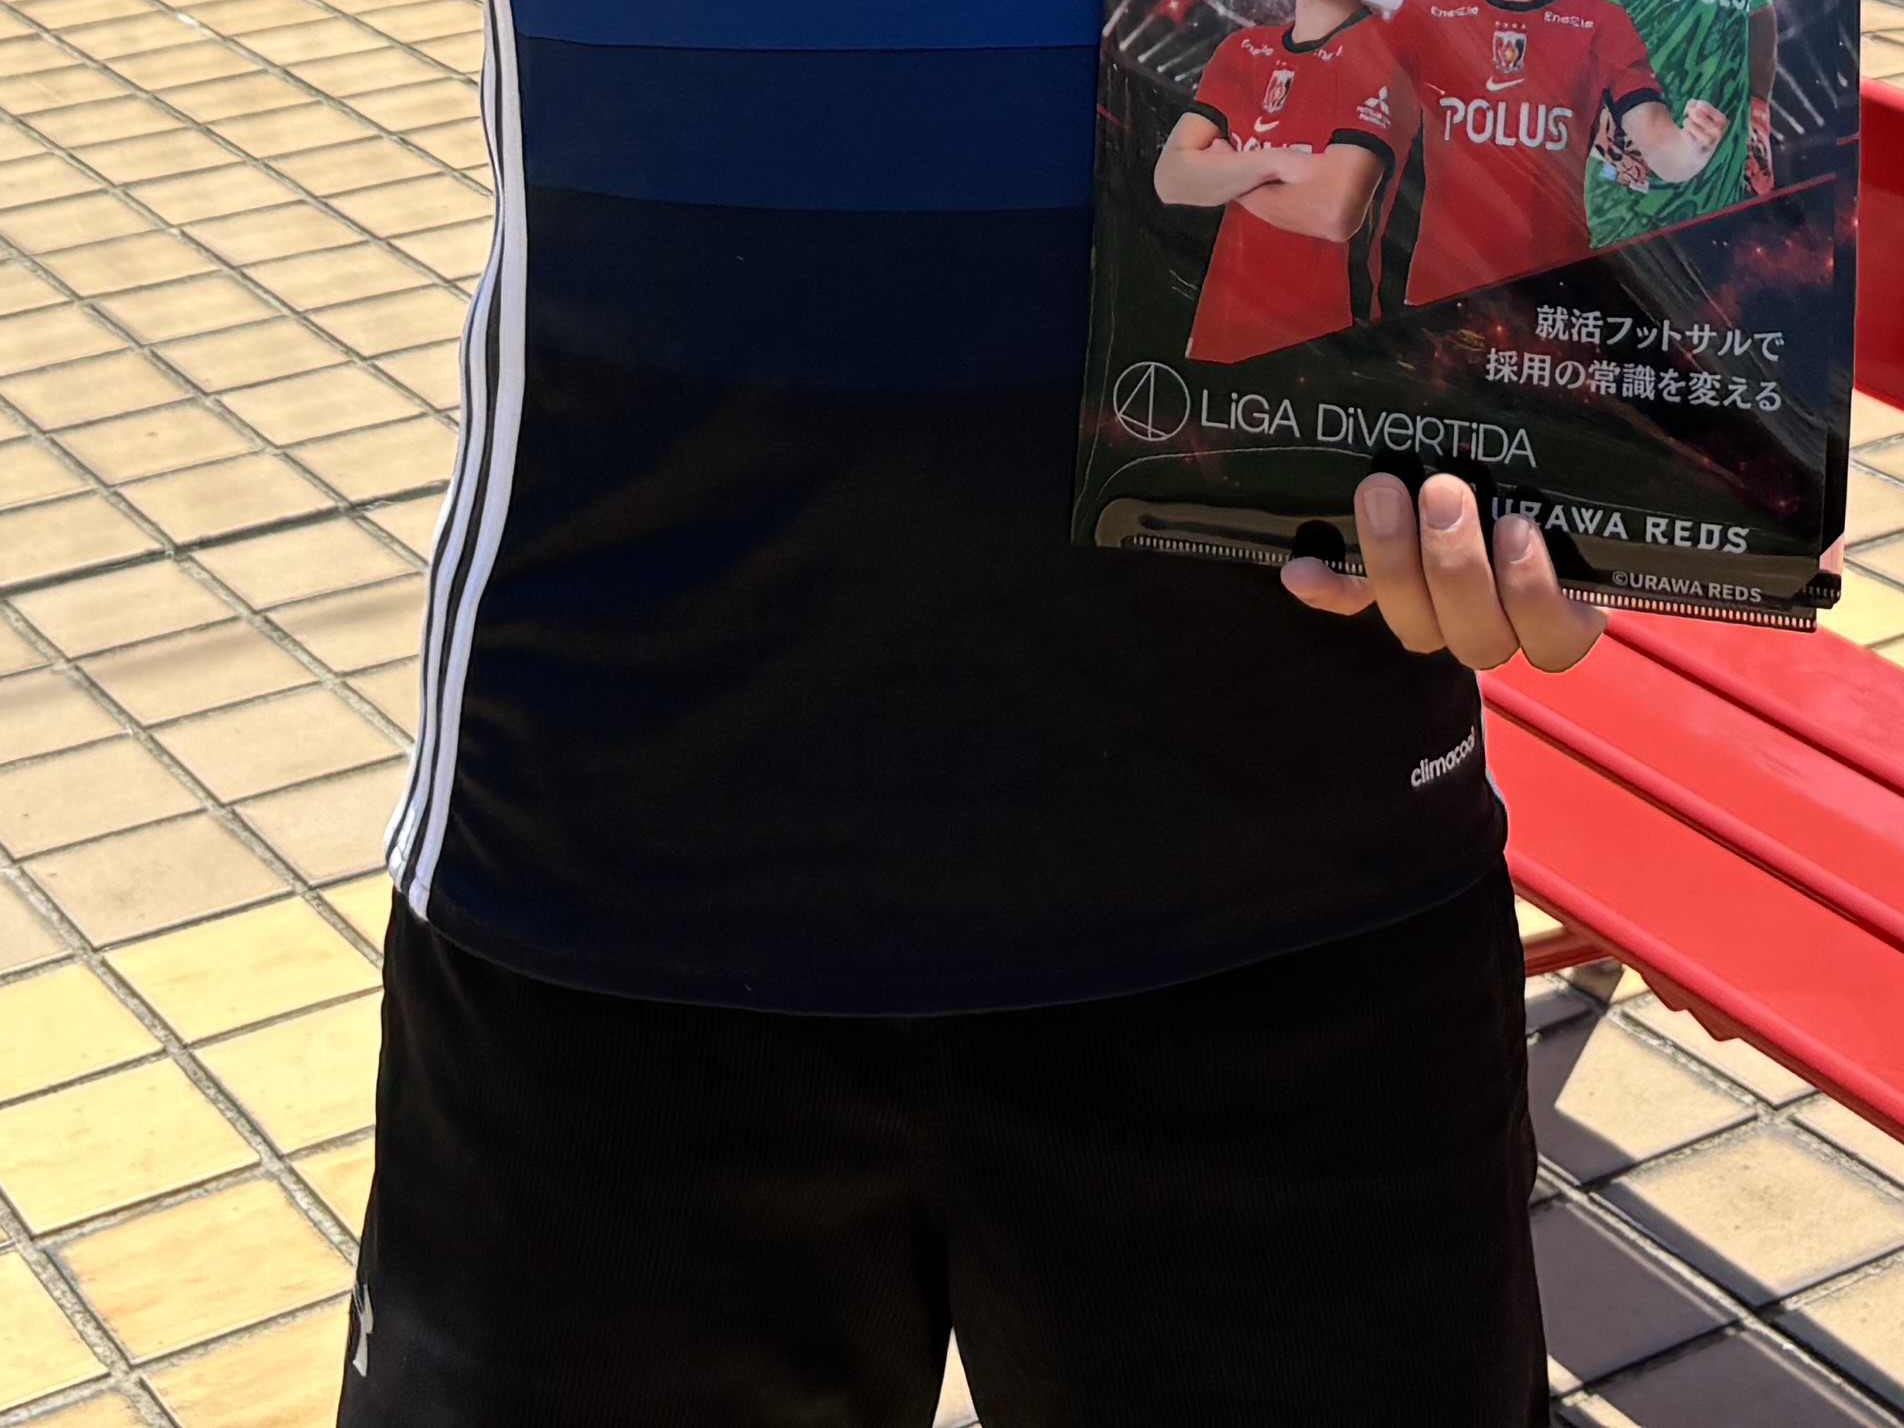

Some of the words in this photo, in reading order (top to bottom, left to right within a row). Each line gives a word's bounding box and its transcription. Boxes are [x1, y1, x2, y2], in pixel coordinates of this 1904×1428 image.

[1440, 97, 1572, 151] POLUS
[1535, 304, 1785, 362] 就活フットサルで
[1485, 347, 1783, 412] 採用の常識を変える
[1645, 516, 1750, 555] REDS
[1708, 582, 1763, 603] REDS
